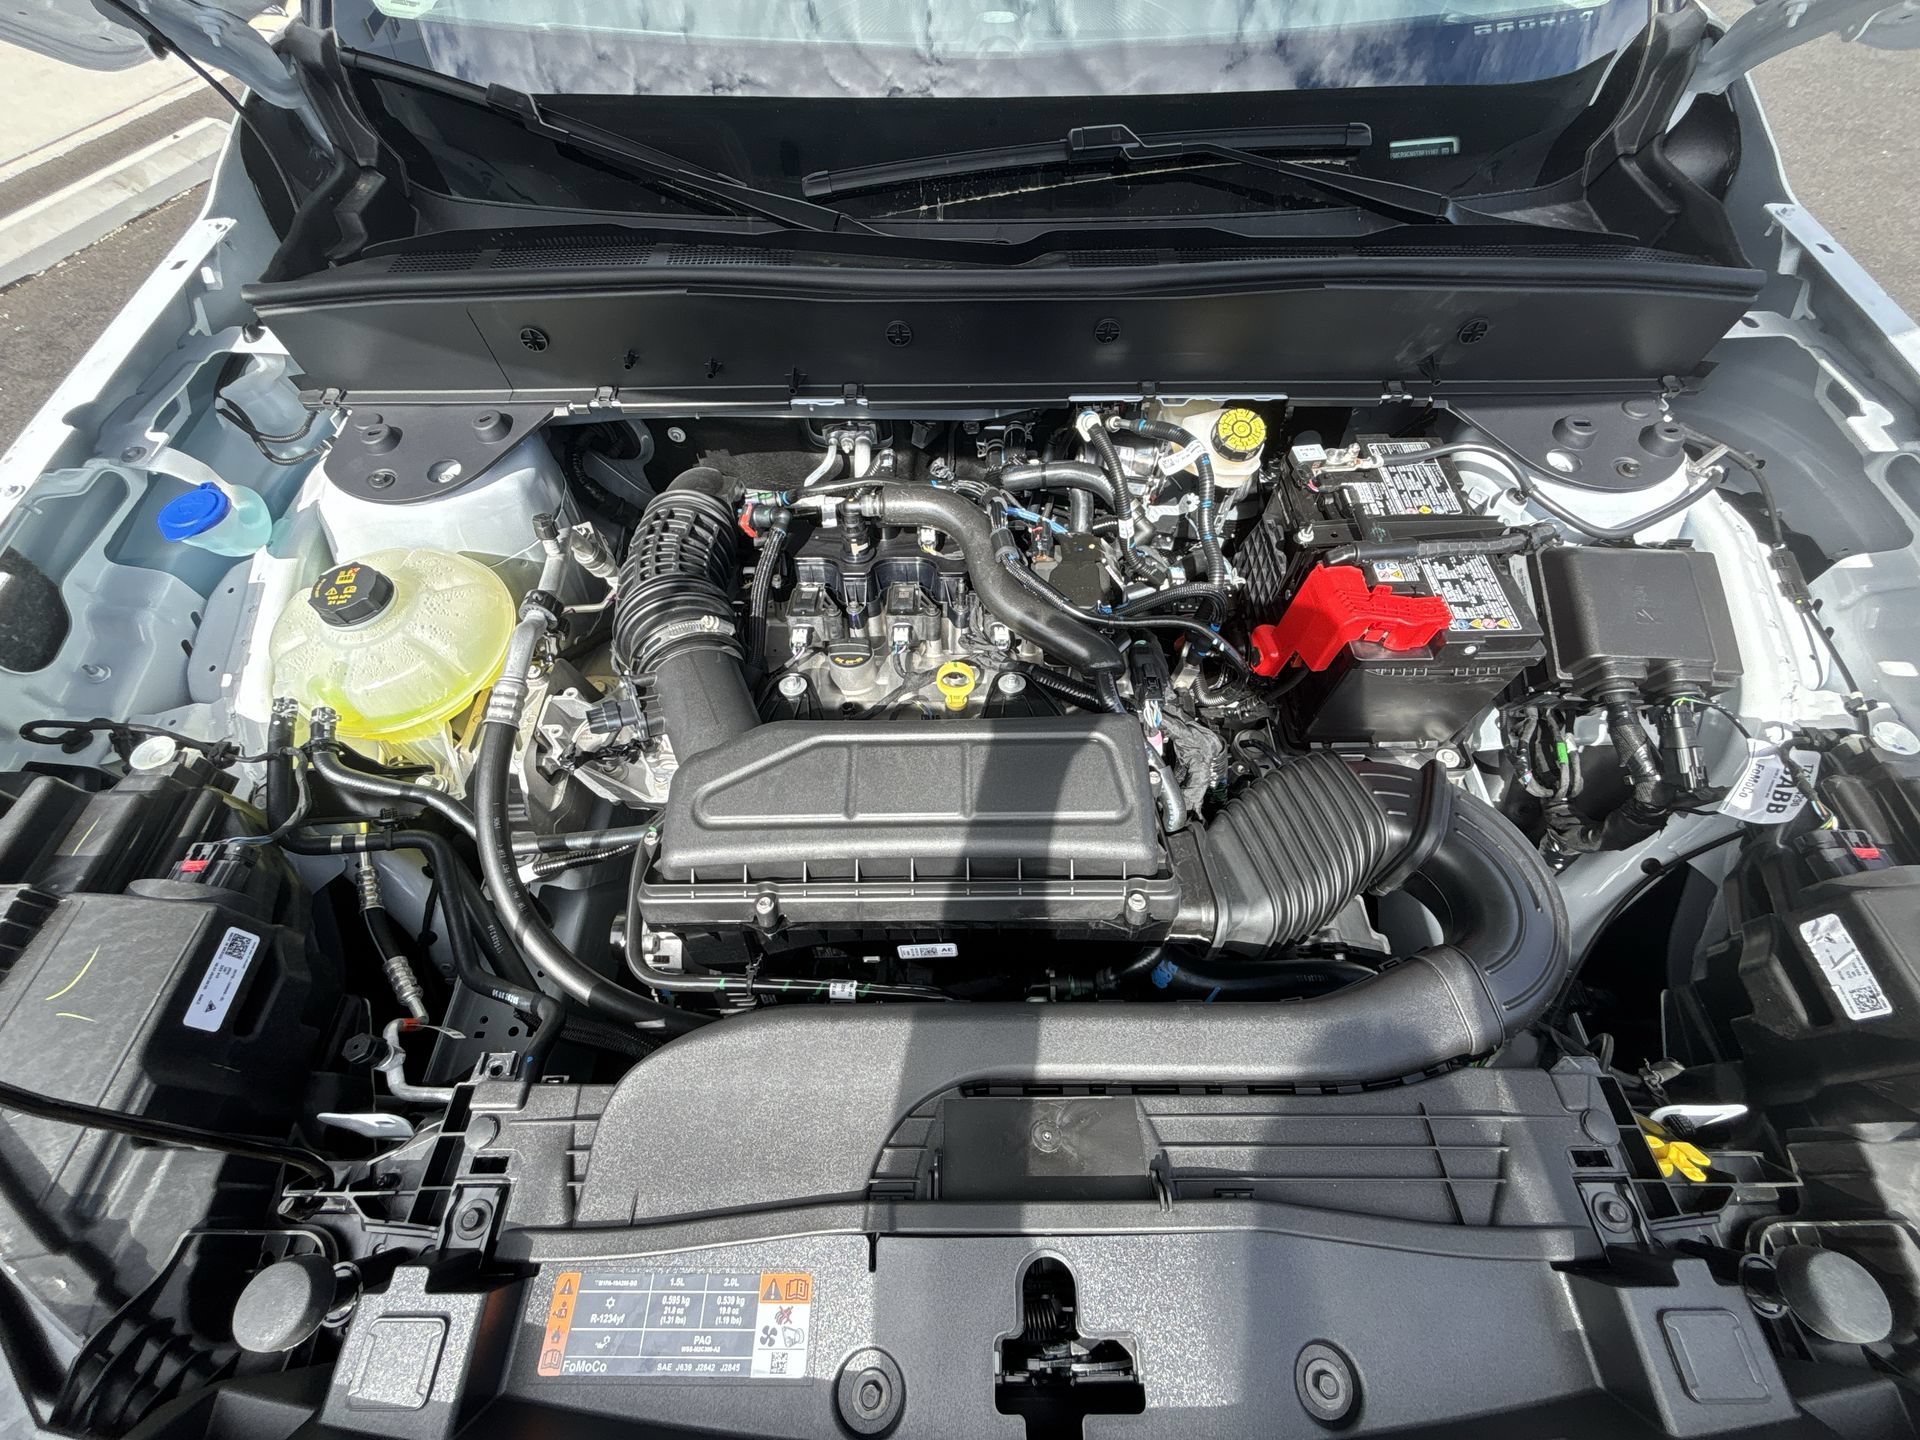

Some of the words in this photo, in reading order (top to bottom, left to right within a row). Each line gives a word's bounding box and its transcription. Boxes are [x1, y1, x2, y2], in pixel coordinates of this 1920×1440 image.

[1738, 763, 1765, 798] FoMoCo
[724, 1278, 740, 1287] 2.0L
[681, 1296, 690, 1307] kg
[736, 1296, 745, 1307] kg
[590, 1314, 626, 1326] R-1234yf
[694, 1335, 712, 1346] PAG
[562, 1360, 608, 1373] FoMoCo
[656, 1363, 672, 1372] SAE
[676, 1364, 692, 1372] J639
[720, 1364, 740, 1372] J2845
